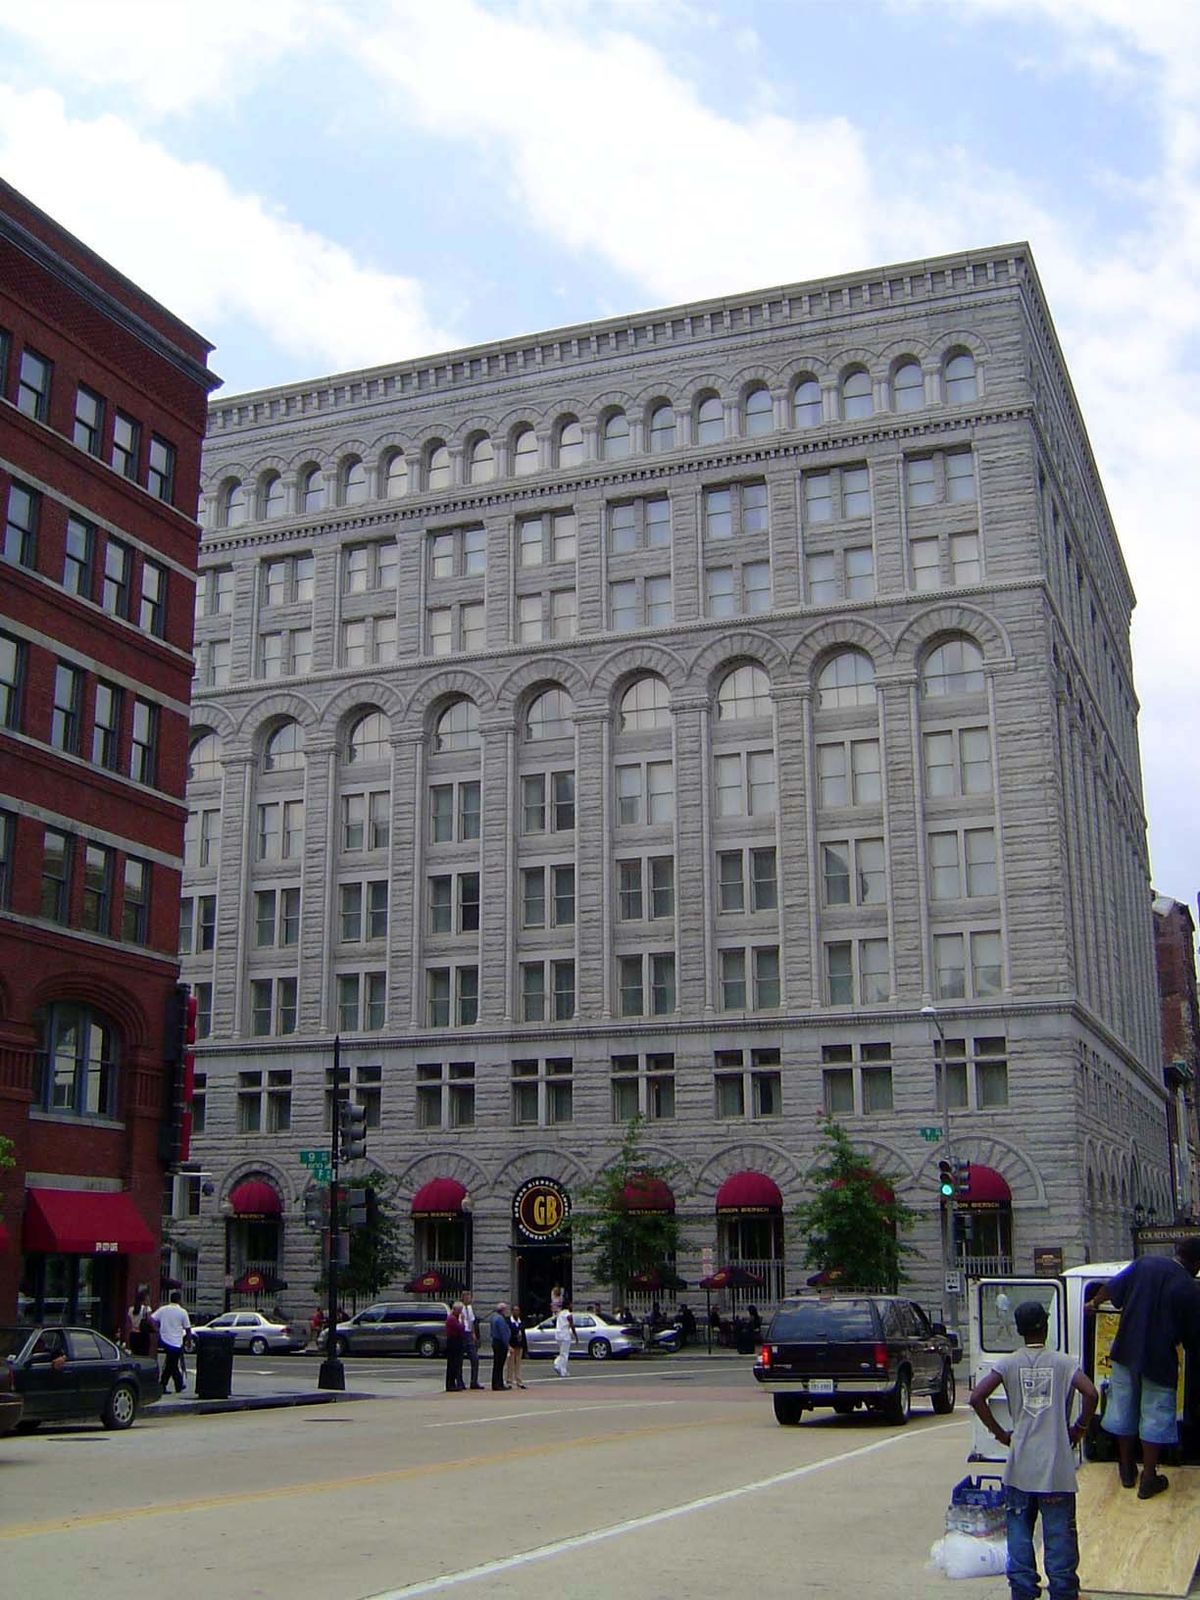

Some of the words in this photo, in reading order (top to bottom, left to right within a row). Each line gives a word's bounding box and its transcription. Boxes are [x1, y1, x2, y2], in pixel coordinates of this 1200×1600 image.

[514, 1188, 527, 1218] GORDON
[534, 1196, 557, 1226] GB
[519, 1224, 547, 1240] BREWERY
[1137, 1231, 1185, 1240] COURTYARD
